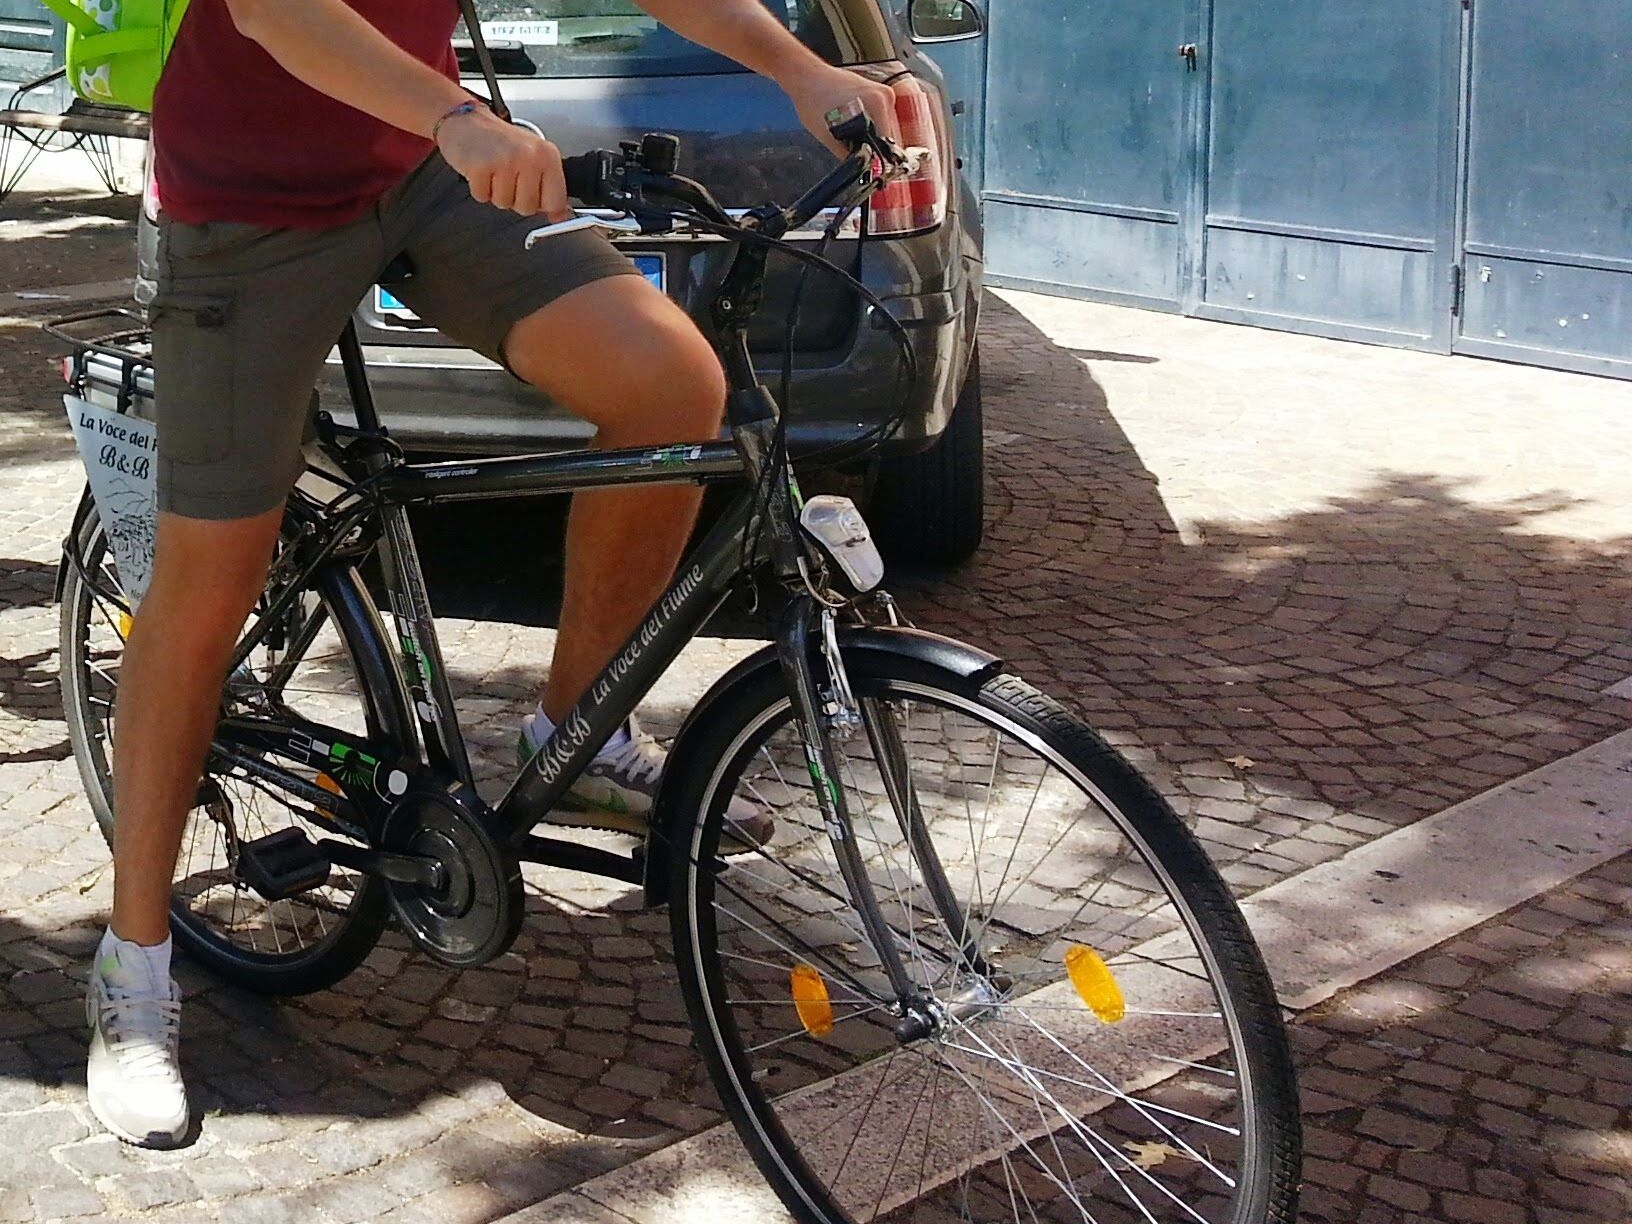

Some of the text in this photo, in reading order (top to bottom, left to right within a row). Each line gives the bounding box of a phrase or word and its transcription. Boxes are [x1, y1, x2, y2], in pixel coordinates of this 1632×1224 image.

[80, 413, 95, 430] La
[99, 418, 127, 441] Voce
[129, 431, 149, 449] del
[99, 444, 150, 480] B&B
[536, 563, 705, 785] B&B La Voce del Fiume
